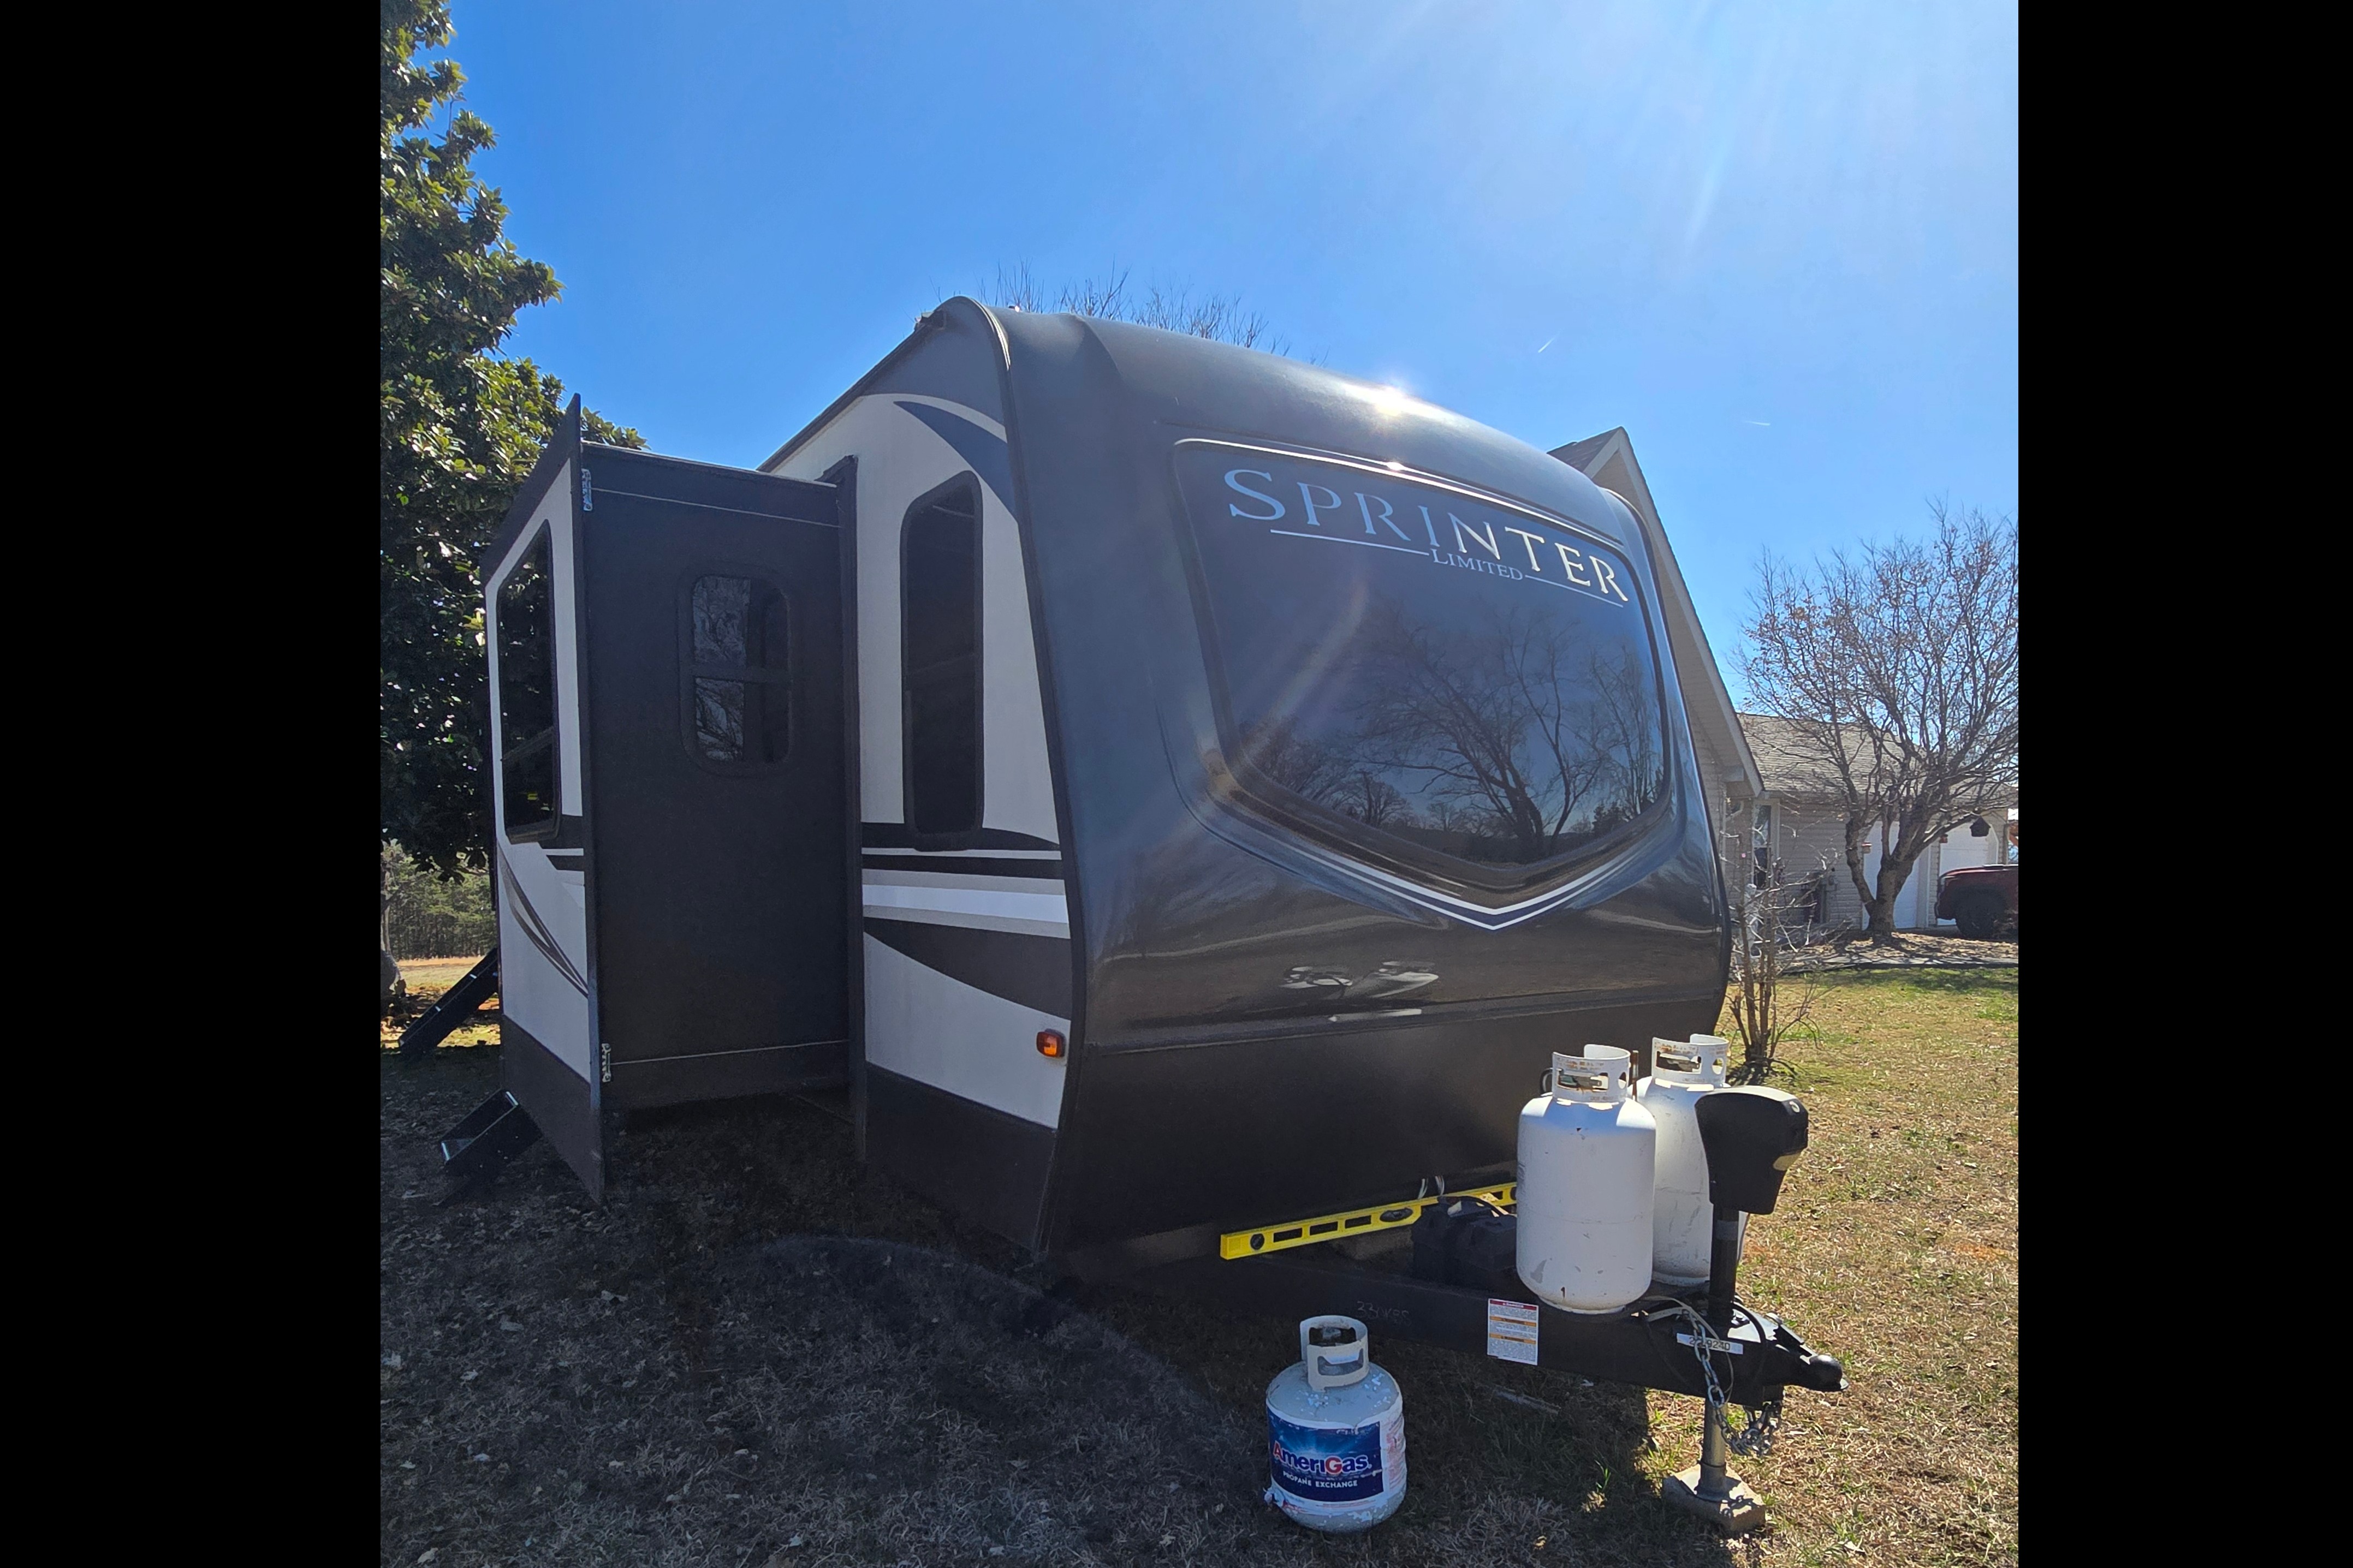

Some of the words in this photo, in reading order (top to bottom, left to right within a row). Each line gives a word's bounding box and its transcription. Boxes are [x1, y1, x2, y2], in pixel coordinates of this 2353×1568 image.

[1224, 468, 1629, 601] SPRINTER
[1430, 548, 1523, 581] LIMITED
[1273, 1440, 1369, 1475] AmeriGas
[1283, 1471, 1311, 1486] PROPANE
[1316, 1480, 1358, 1488] EXCHANGE
